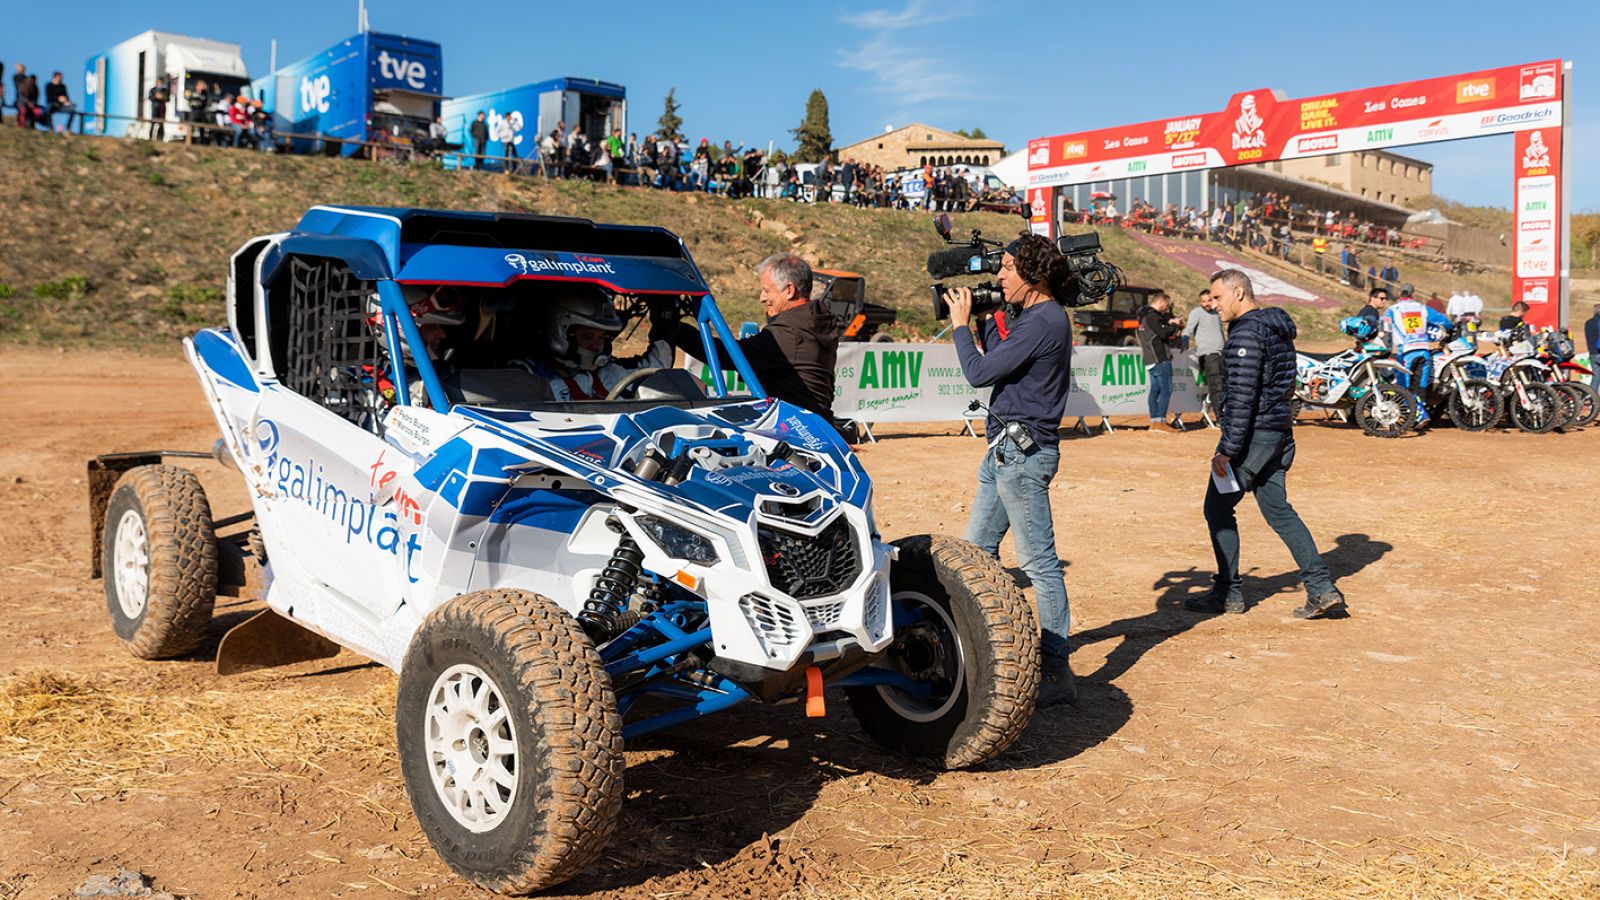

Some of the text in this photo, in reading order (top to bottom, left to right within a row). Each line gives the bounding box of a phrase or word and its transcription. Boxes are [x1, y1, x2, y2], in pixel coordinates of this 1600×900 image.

[377, 50, 427, 89] tve
[300, 74, 330, 114] tve
[1462, 82, 1489, 97] rtve
[1301, 98, 1339, 111] DREAM.
[1364, 96, 1426, 113] Les Comes
[1481, 108, 1552, 126] BFGoodrich
[1164, 117, 1202, 134] JANUARY
[1301, 120, 1323, 130] LIVE
[1104, 139, 1120, 150] Les
[1300, 138, 1338, 151] MOTUL
[1237, 149, 1262, 160] 2020
[528, 259, 616, 274] galimplant
[1408, 318, 1419, 328] 25
[938, 384, 950, 395] 902
[952, 384, 963, 394] 125
[858, 400, 866, 410] El
[866, 398, 889, 410] seguro
[370, 450, 422, 526] tem
[278, 457, 422, 584] galimplat
